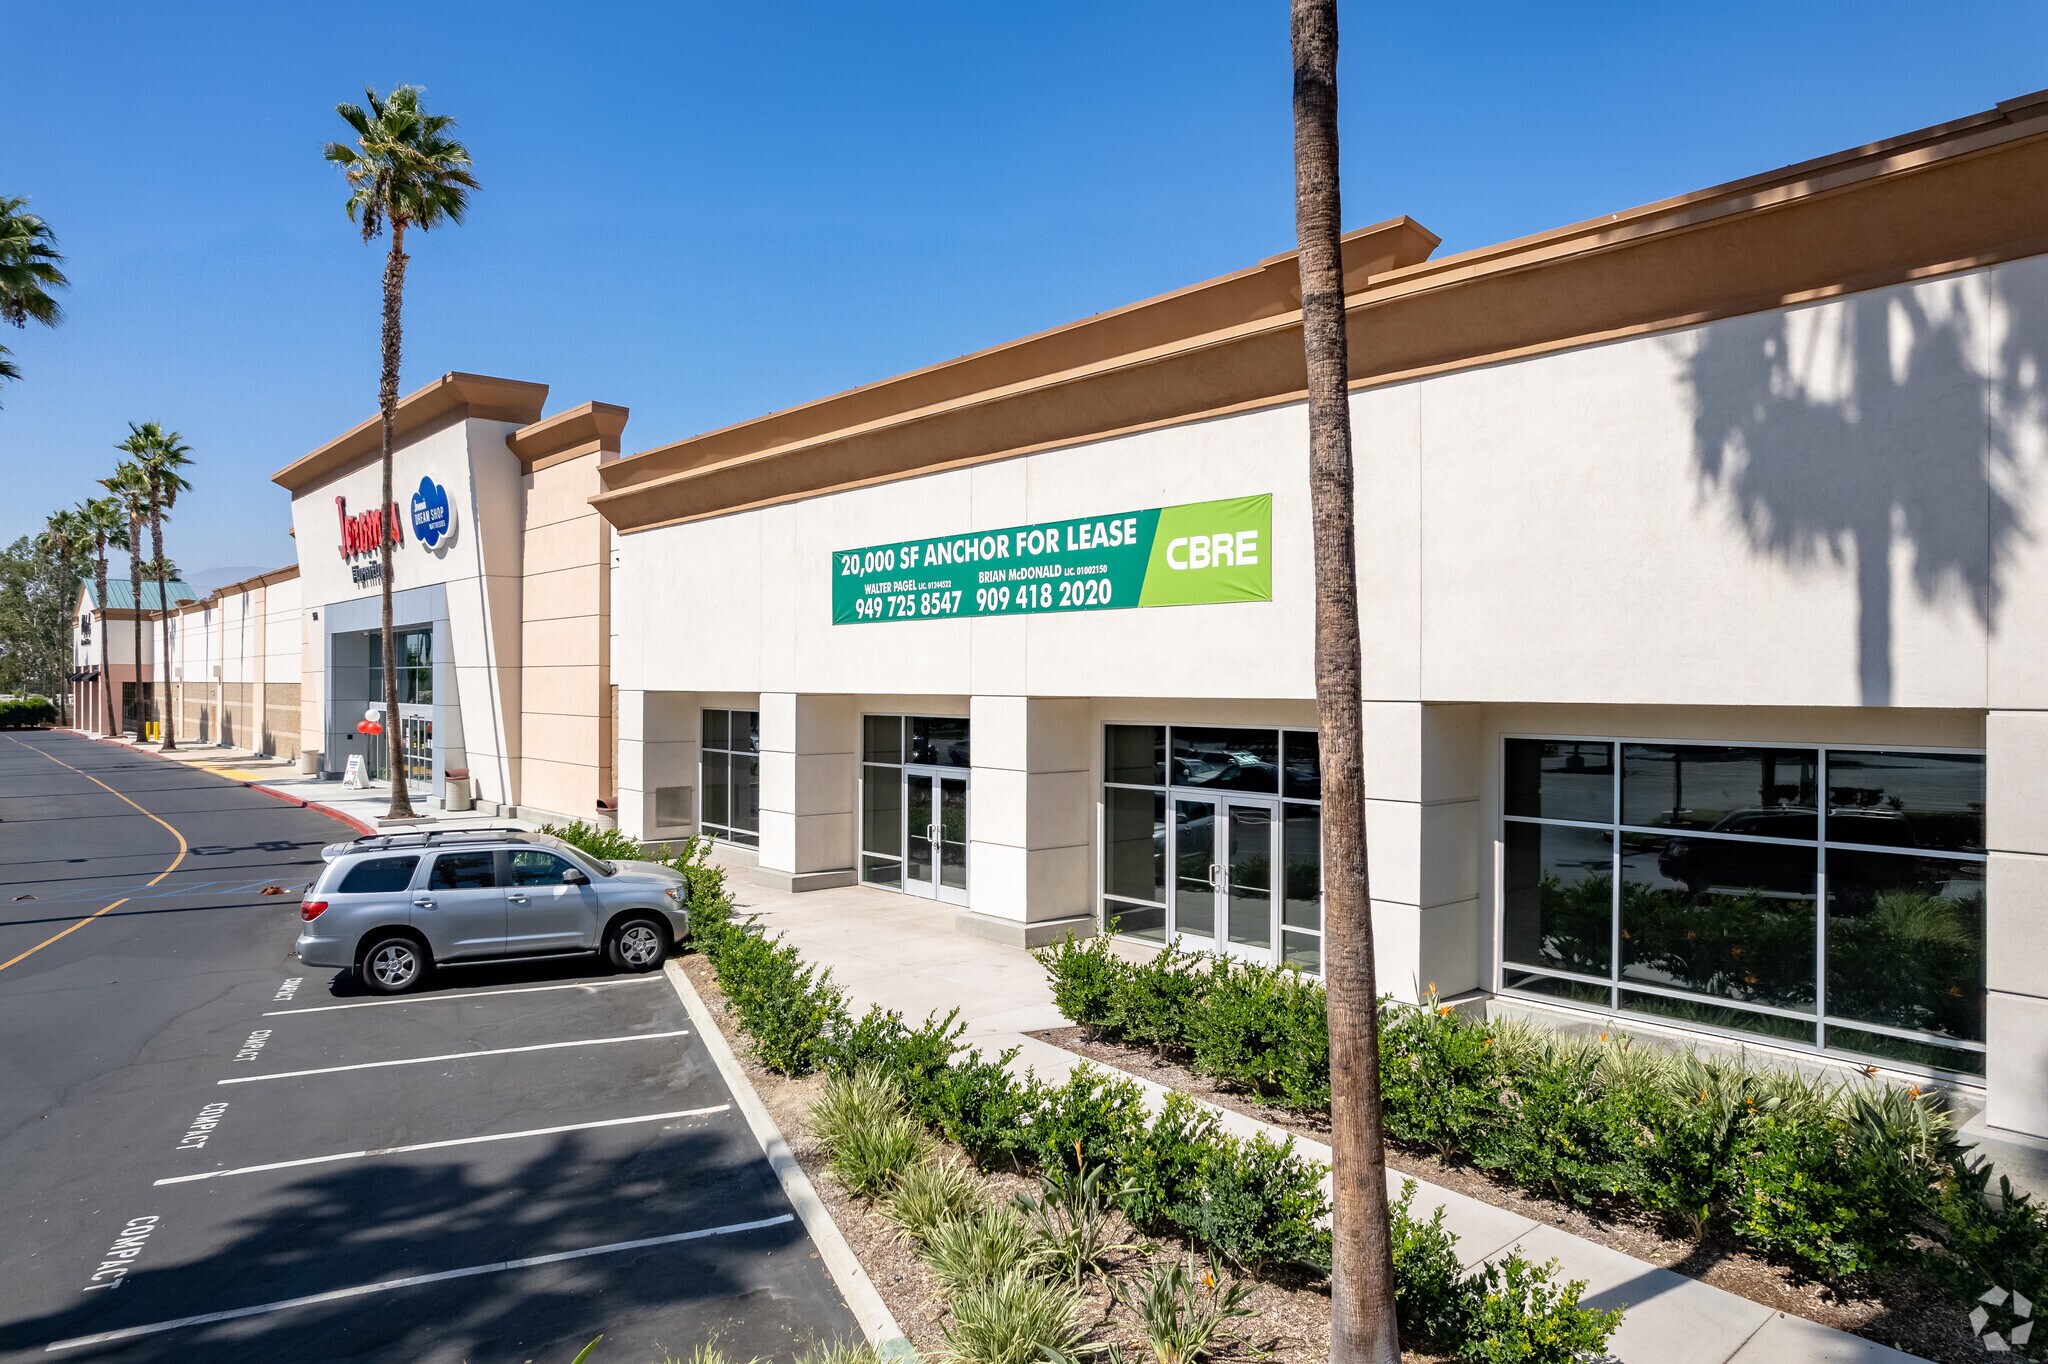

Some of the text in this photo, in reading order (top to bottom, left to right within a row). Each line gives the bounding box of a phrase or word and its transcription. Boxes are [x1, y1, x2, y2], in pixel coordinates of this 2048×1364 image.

[431, 506, 444, 521] SHOP
[841, 518, 1137, 578] 20,000 SF ANCHOR FOR LEASE
[1166, 530, 1258, 571] CBRE
[864, 581, 892, 595] WALTER
[893, 579, 917, 592] PAGEL
[918, 582, 927, 590] LIC.
[978, 570, 1006, 584] BRIAN
[1008, 564, 1062, 581] McDONALD
[1064, 567, 1075, 576] LIC.
[855, 590, 962, 619] 949 725 8547
[976, 578, 1112, 612] 909 418 2020
[233, 1029, 273, 1062] COMPACT
[176, 1102, 229, 1150] COMPACT
[83, 1215, 160, 1292] COMPACT
